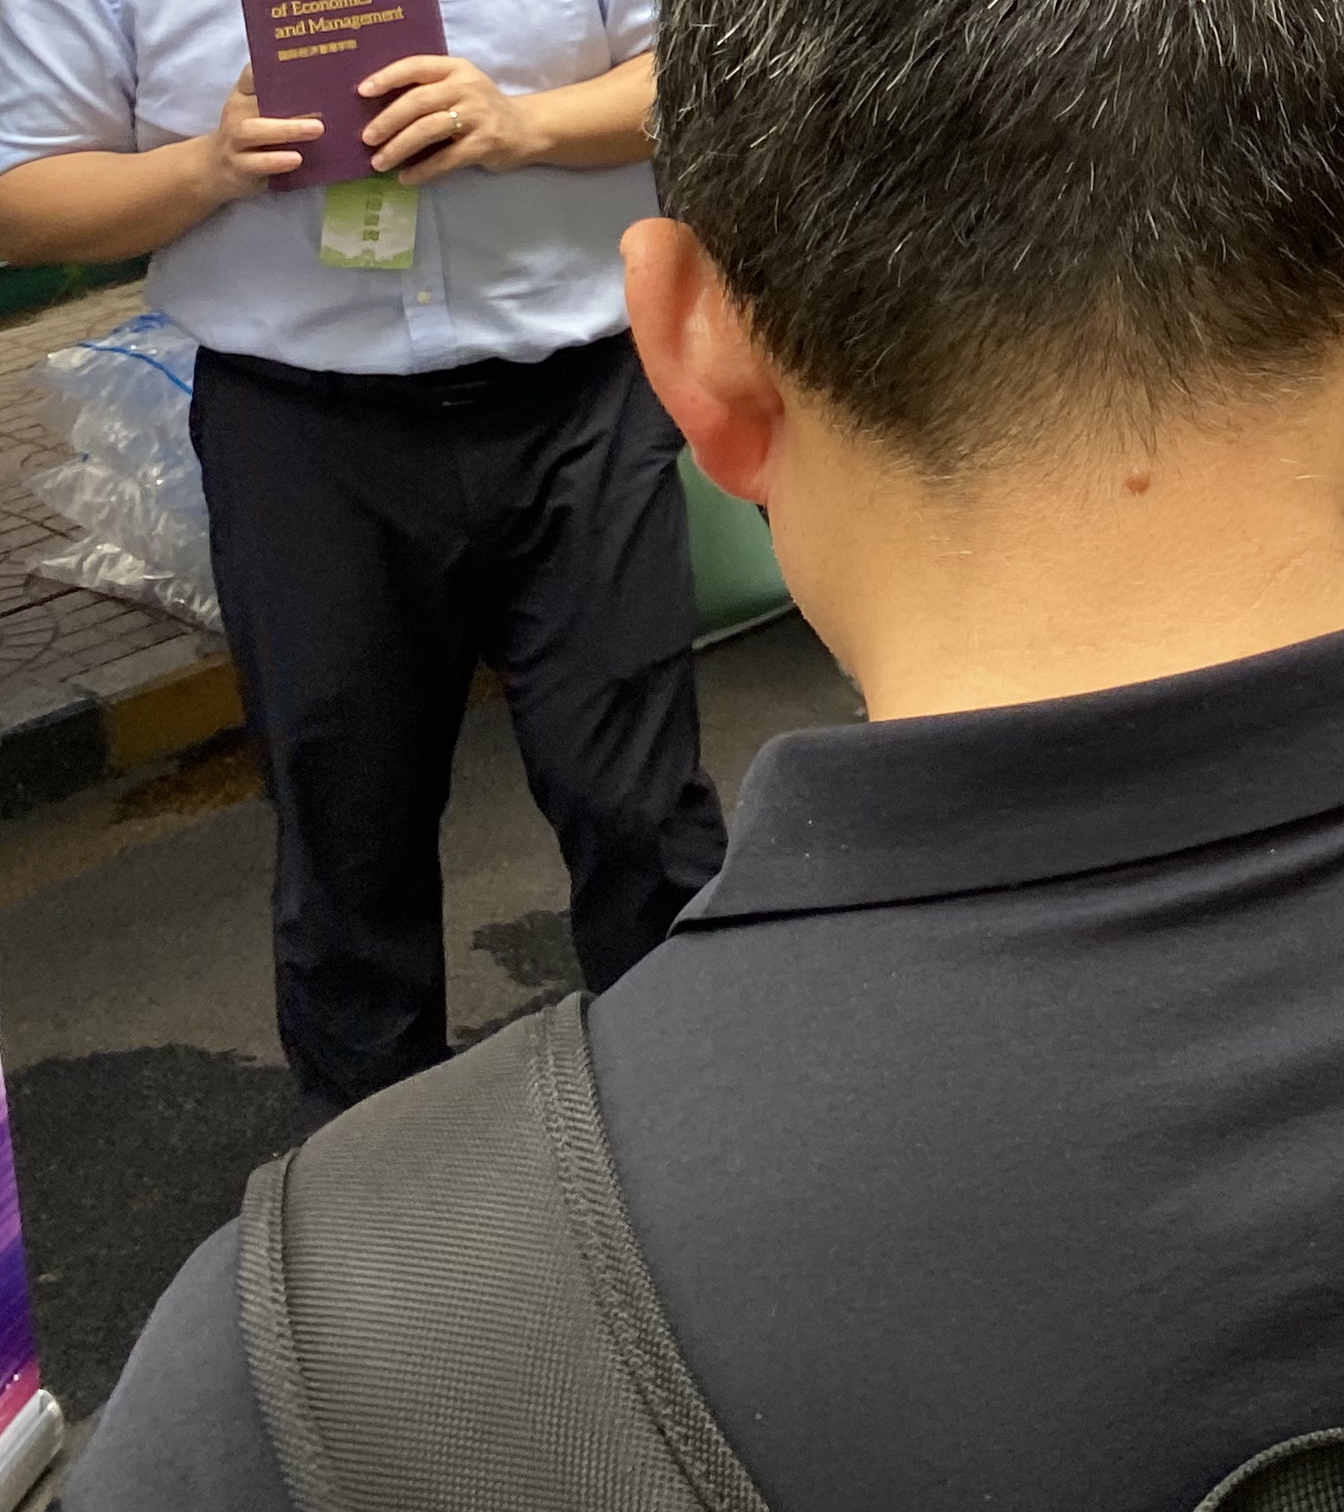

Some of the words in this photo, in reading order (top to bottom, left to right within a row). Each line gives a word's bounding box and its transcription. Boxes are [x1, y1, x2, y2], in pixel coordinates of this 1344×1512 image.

[271, 2, 288, 18] of
[275, 20, 306, 39] and
[309, 7, 404, 34] Management
